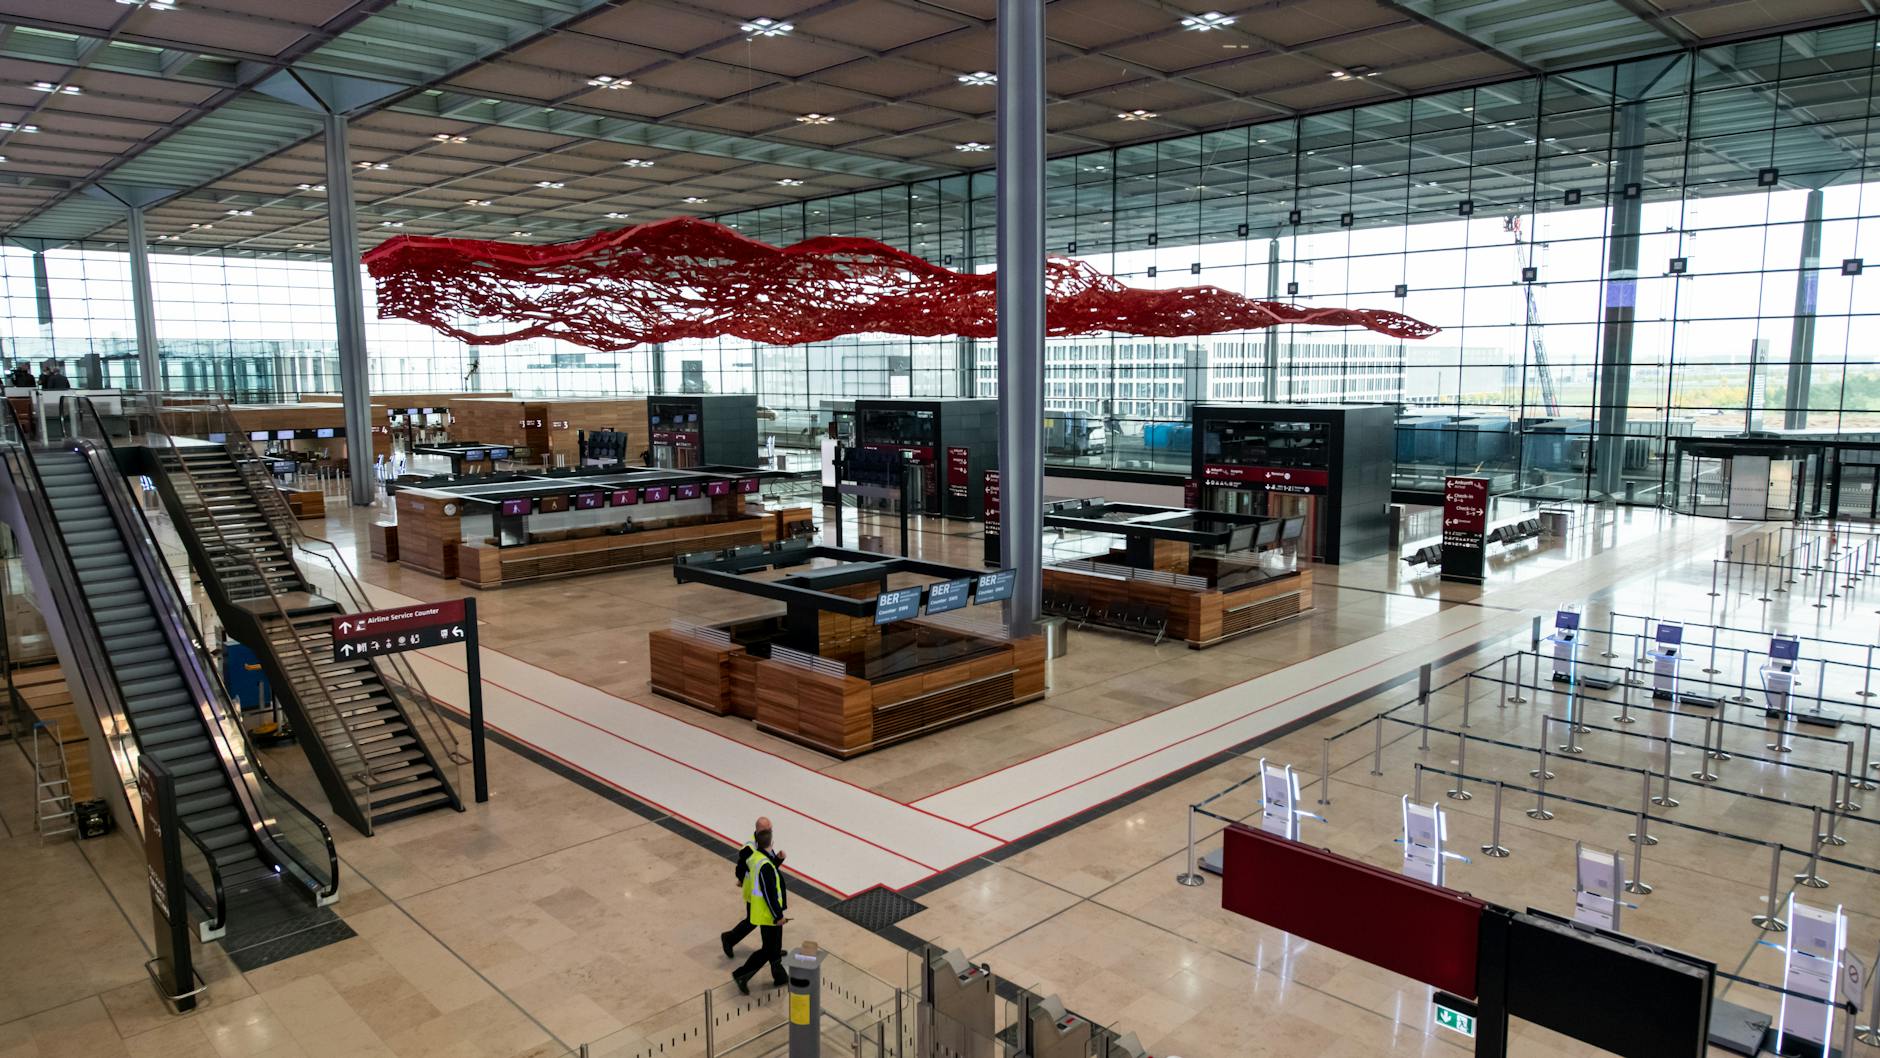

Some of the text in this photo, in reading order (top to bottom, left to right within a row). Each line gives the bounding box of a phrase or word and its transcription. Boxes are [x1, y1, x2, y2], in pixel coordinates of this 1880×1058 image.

[536, 419, 542, 428] 3
[563, 421, 569, 429] 3
[980, 574, 997, 587] BER
[931, 583, 951, 597] BER
[880, 592, 900, 607] BER
[367, 607, 440, 624] Airline Service Counter
